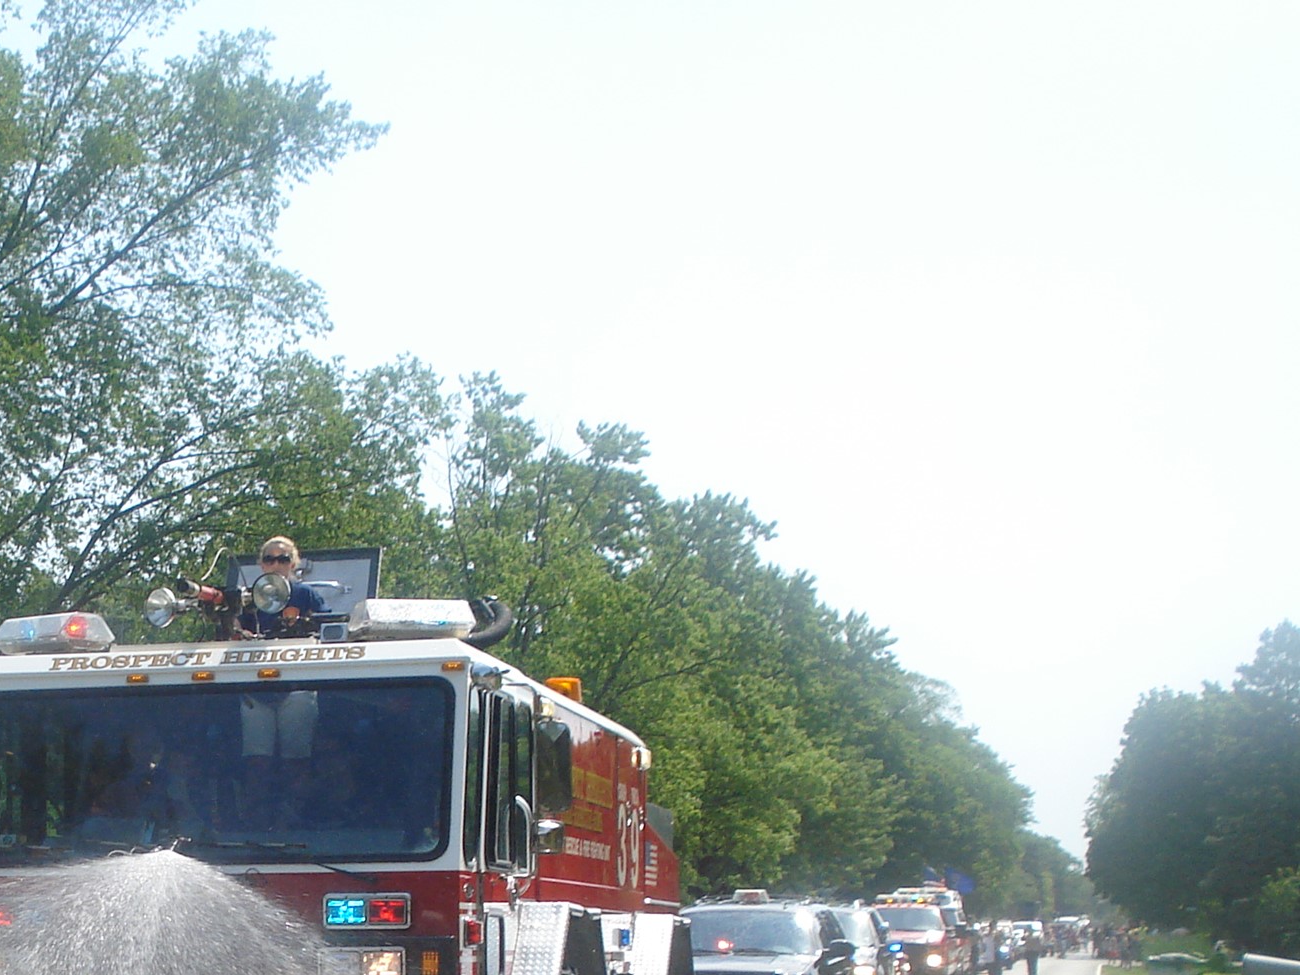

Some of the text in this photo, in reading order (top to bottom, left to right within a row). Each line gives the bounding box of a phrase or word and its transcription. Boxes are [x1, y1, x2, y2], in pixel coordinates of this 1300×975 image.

[49, 646, 366, 671] PROSPECT HEIGHTS
[617, 803, 639, 889] 39
